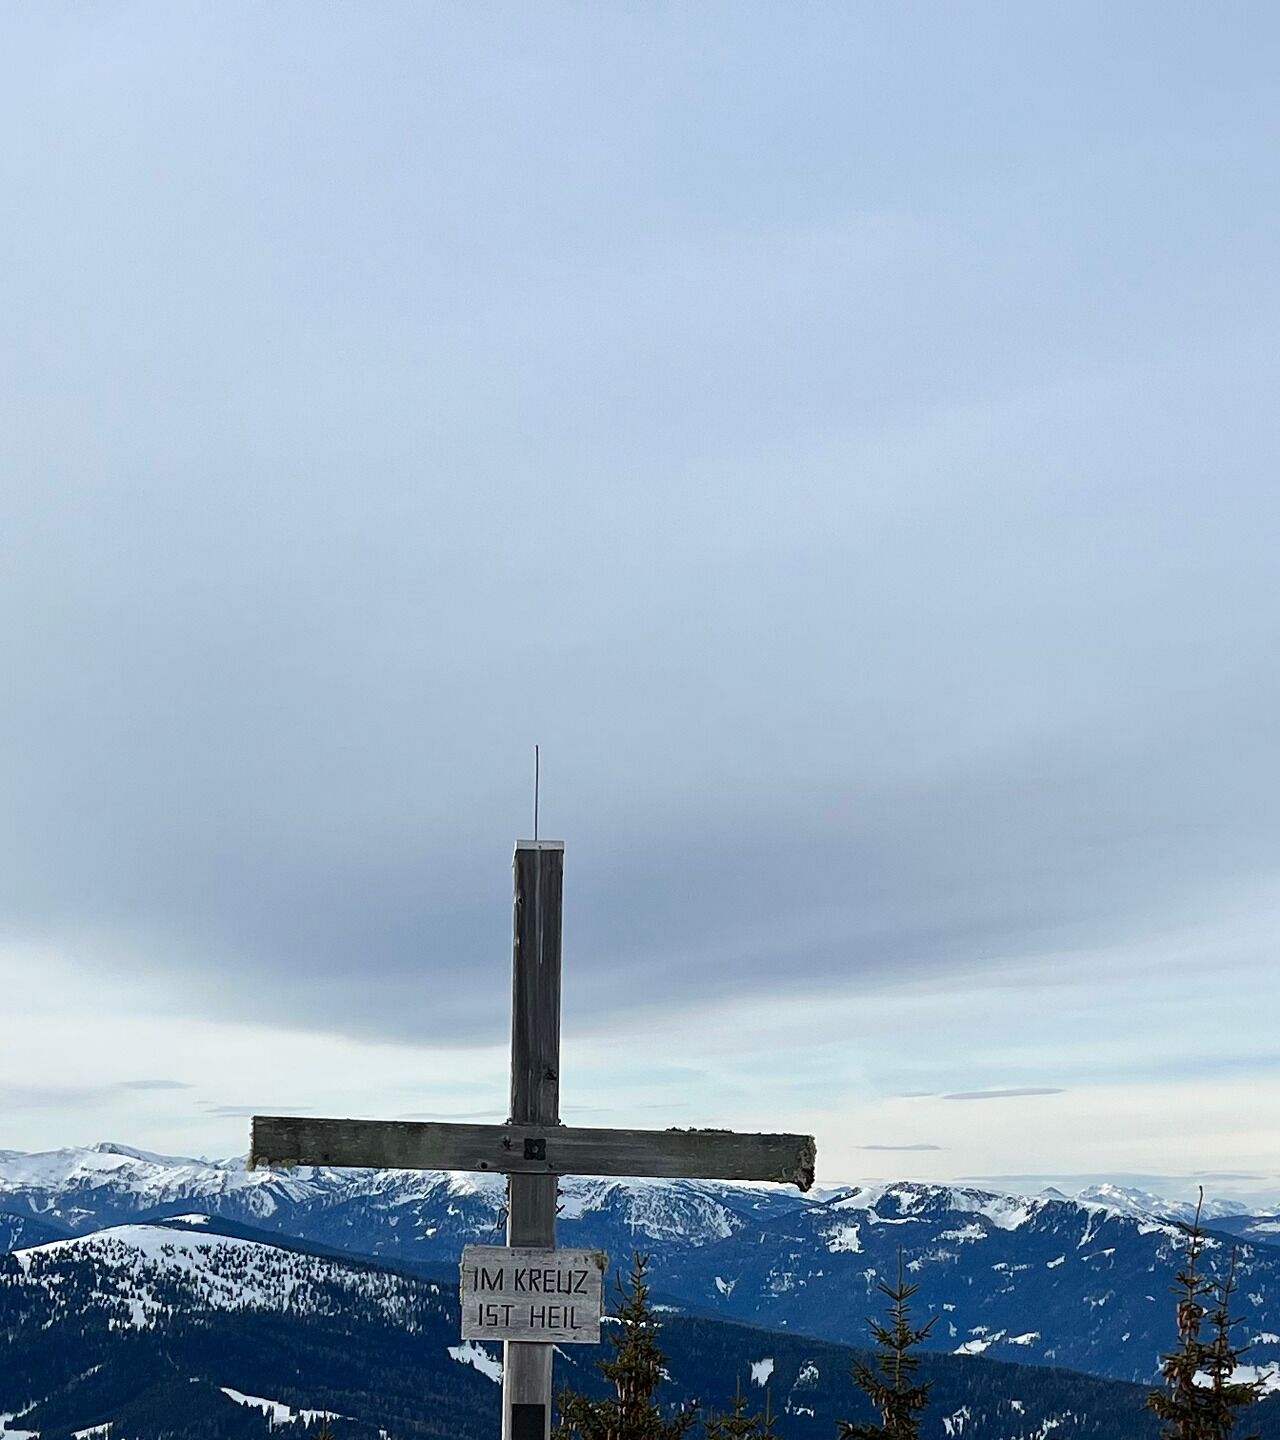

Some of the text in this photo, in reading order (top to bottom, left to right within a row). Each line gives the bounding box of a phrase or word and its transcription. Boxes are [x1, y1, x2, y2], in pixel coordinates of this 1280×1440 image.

[474, 1266, 589, 1295] IM KREUZ
[478, 1303, 582, 1330] IST HEIL
